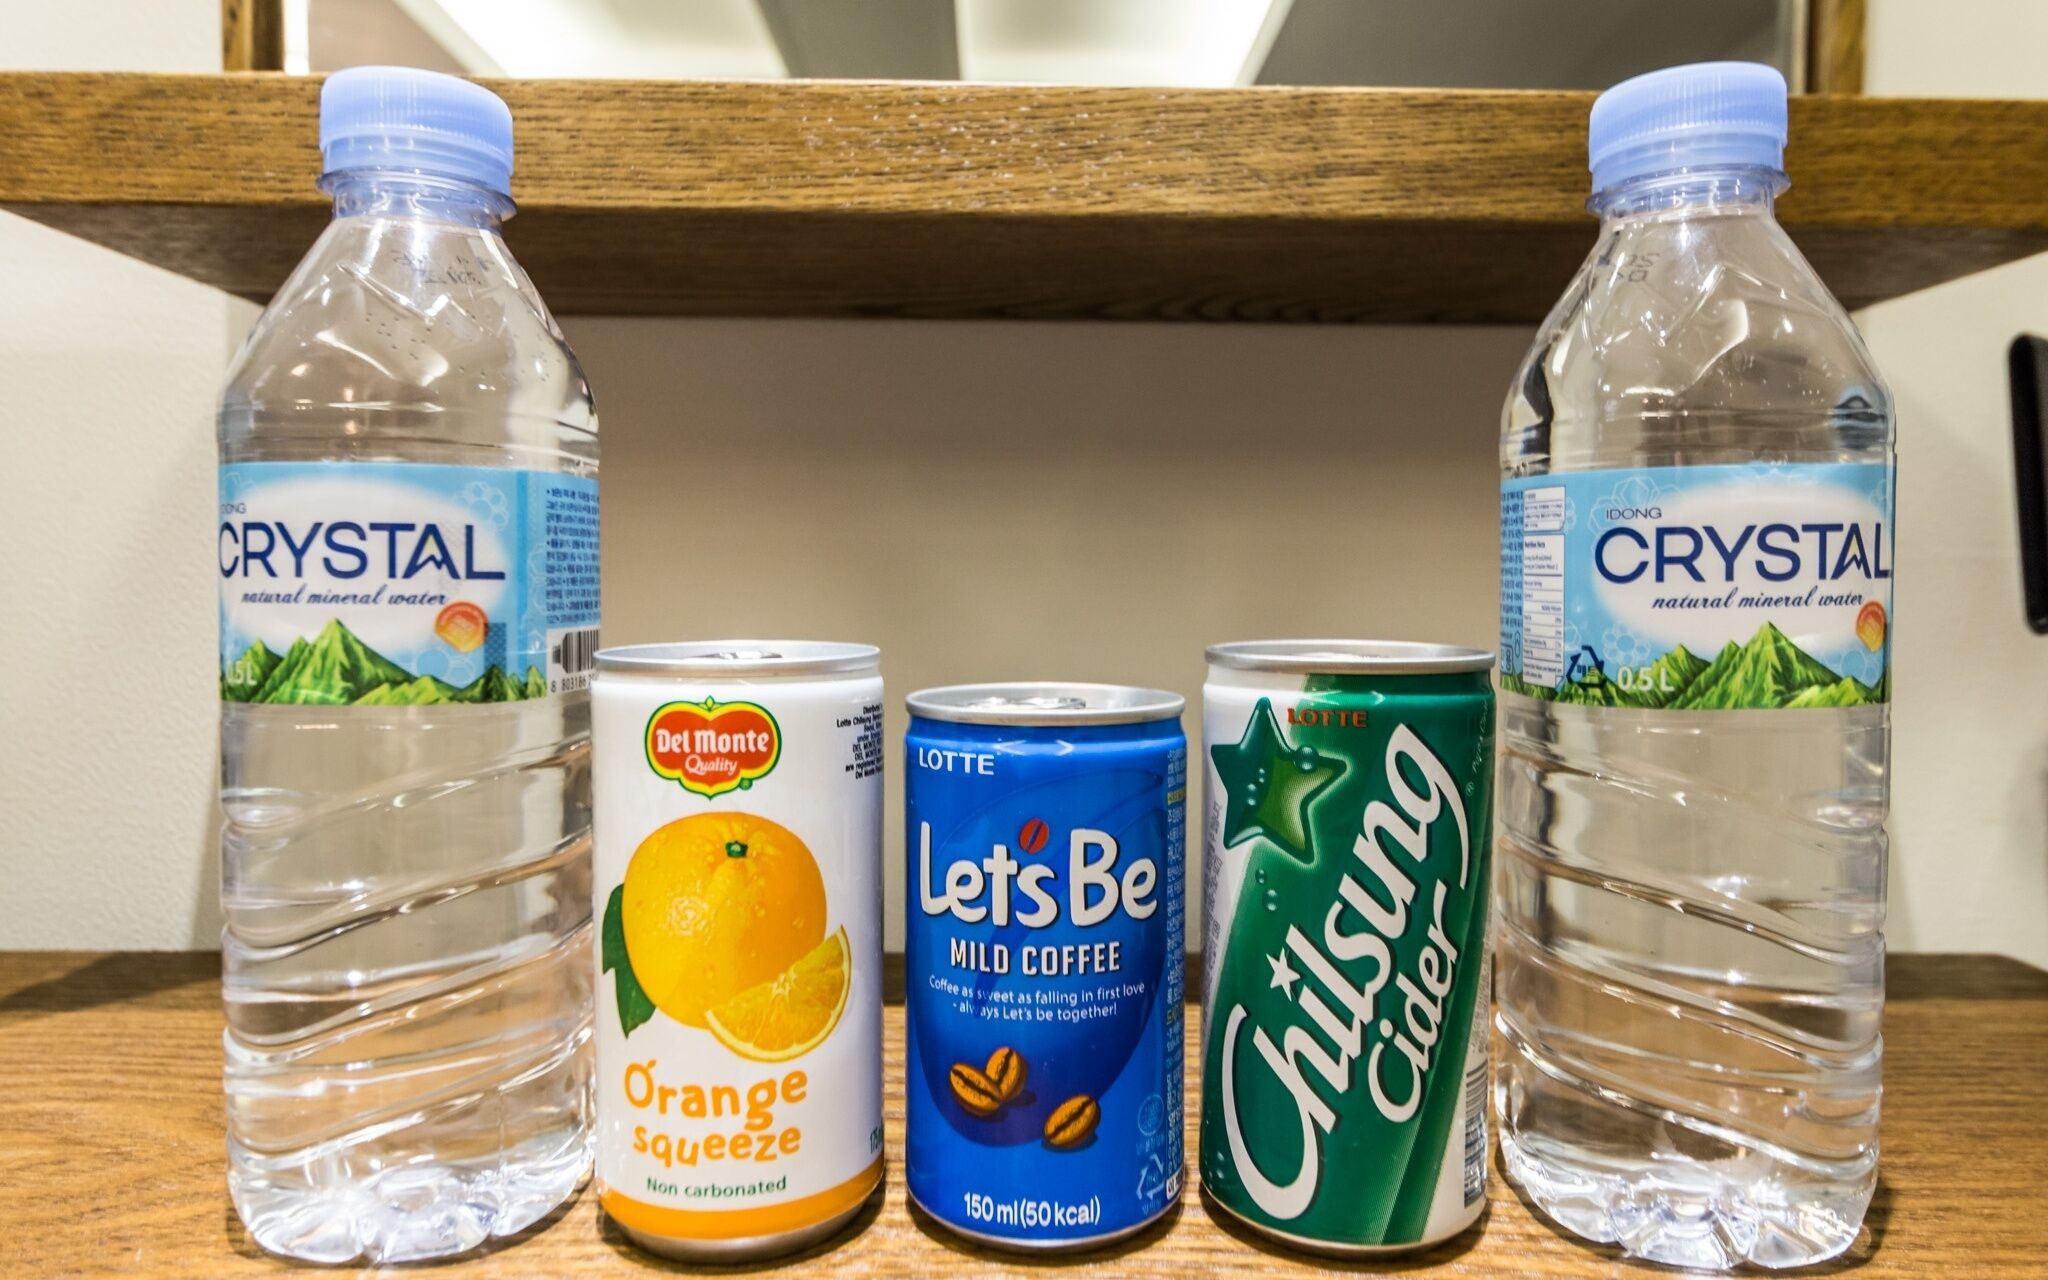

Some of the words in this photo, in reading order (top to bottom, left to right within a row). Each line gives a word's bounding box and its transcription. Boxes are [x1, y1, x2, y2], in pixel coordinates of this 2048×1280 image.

[1605, 506, 1662, 520] IDONG
[219, 521, 506, 581] CRYSTAL
[1594, 522, 1892, 584] CRYSTAL
[241, 583, 307, 605] natural
[306, 584, 390, 606] mineral
[389, 591, 447, 606] water
[1652, 586, 1737, 609] natural
[1737, 586, 1818, 608] mineral
[1818, 592, 1863, 607] water
[1617, 666, 1654, 692] 0.5
[1660, 667, 1675, 691] L
[1287, 707, 1369, 728] LOTTE
[656, 728, 690, 754] Del
[694, 730, 770, 753] Monte
[685, 756, 737, 776] Quality
[918, 747, 995, 775] LOTTE
[1069, 828, 1158, 926] Be
[950, 937, 1010, 975] MILD
[1022, 941, 1121, 977] COFFEE
[1221, 722, 1470, 1221] Chilsung
[928, 974, 961, 996] Coffee
[961, 986, 975, 998] as
[1017, 993, 1033, 1005] as
[1034, 990, 1079, 1008] falling
[1081, 988, 1096, 1003] in
[1096, 984, 1121, 1001] first
[1122, 981, 1147, 997] love
[1367, 878, 1458, 1124] Cider
[1002, 1005, 1034, 1021] Let's
[1035, 1005, 1055, 1022] be
[1056, 1001, 1119, 1024] together!
[632, 1125, 804, 1169] squeeze
[647, 1176, 679, 1197] Non
[683, 1175, 788, 1199] carbonated
[963, 1192, 994, 1222] 150
[1054, 1195, 1101, 1226] kcal)
